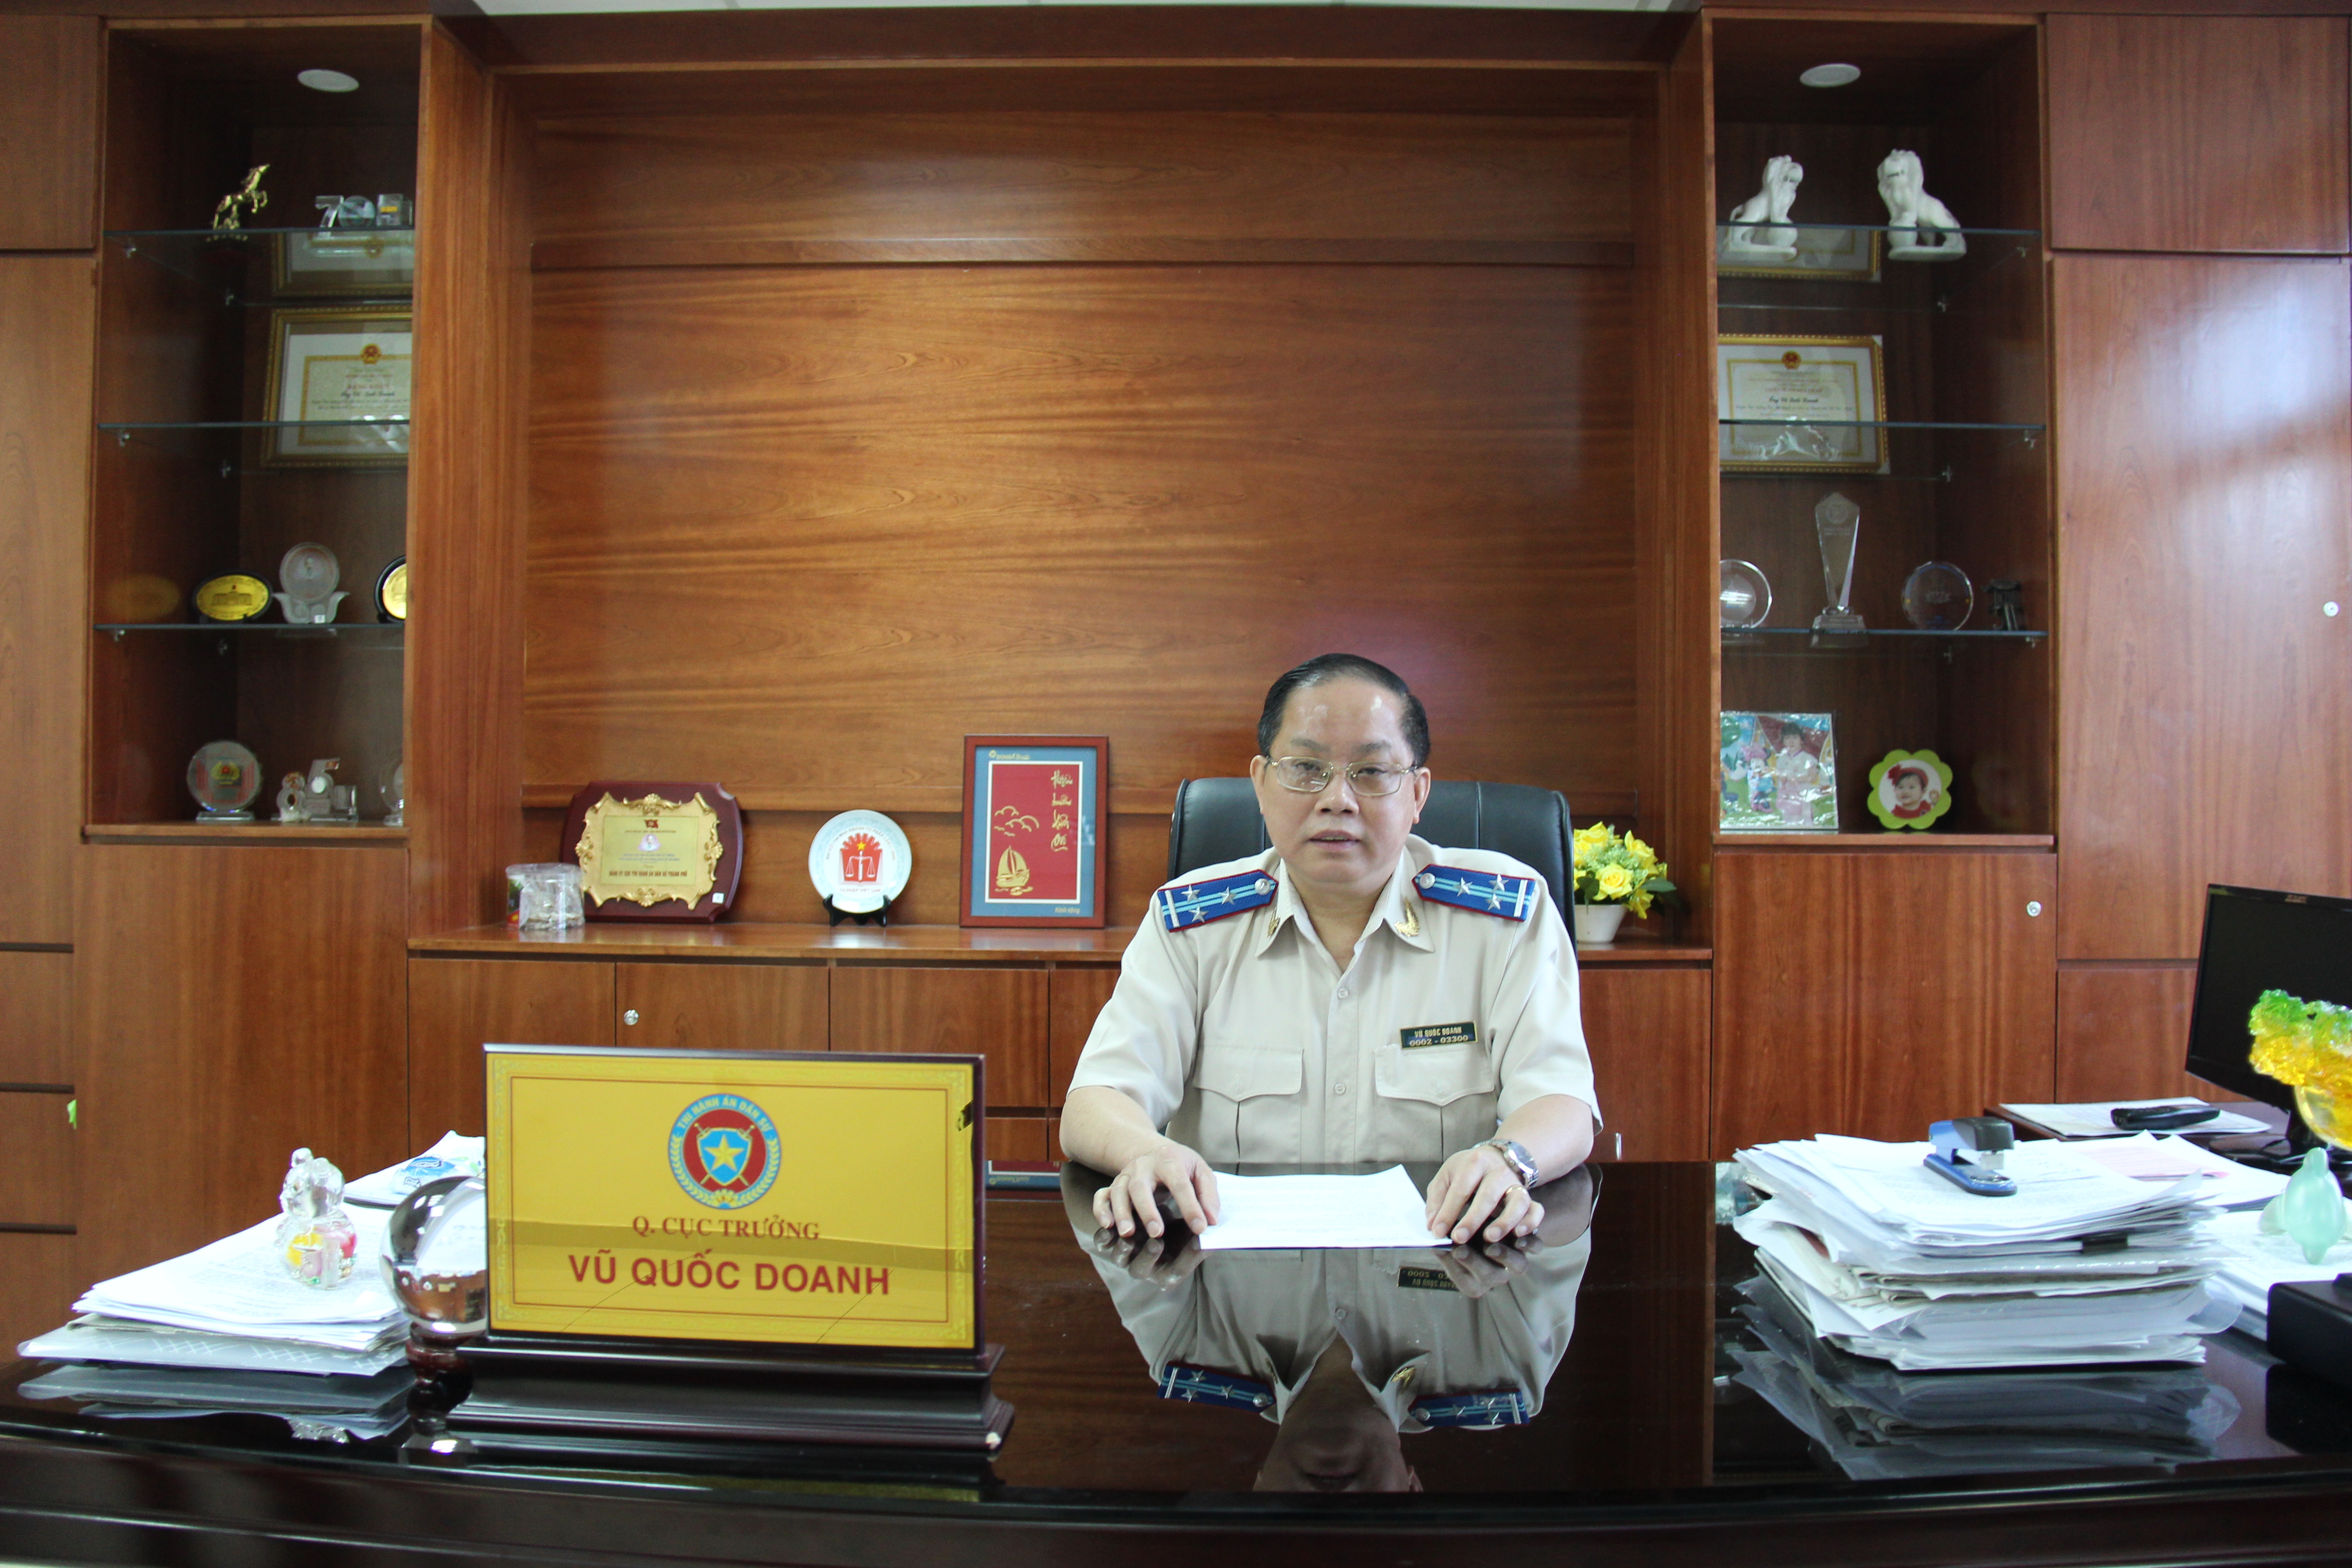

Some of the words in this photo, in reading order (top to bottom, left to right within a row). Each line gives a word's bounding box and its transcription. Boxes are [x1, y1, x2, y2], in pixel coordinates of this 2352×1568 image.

[1409, 1039, 1432, 1047] 0002
[677, 1112, 693, 1128] THI
[632, 1215, 656, 1237] Q.
[662, 1216, 712, 1239] CỤC
[718, 1215, 820, 1240] TRƯỞNG
[568, 1249, 617, 1284] VŨ
[631, 1248, 740, 1290] QUỐC
[755, 1263, 889, 1295] DOANH
